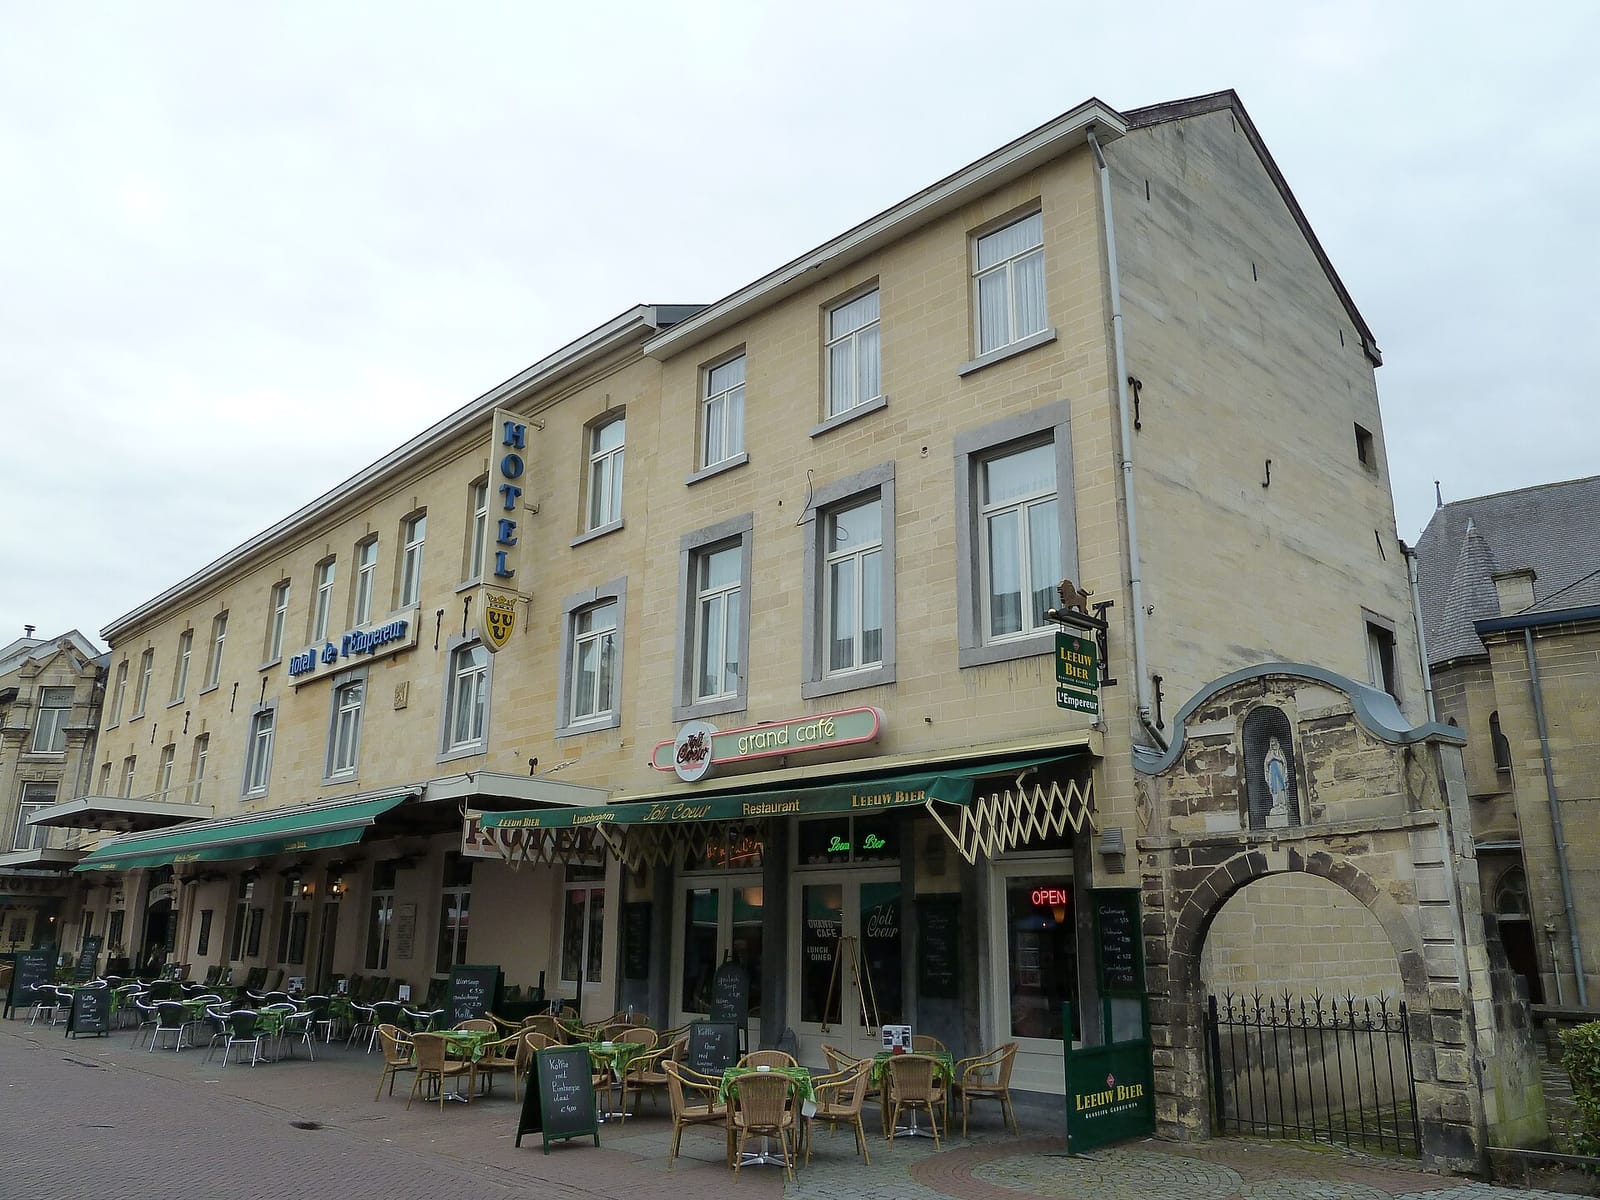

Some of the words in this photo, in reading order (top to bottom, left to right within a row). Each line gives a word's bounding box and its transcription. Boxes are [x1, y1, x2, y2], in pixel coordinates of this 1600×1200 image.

[494, 420, 527, 578] HOTEL
[289, 648, 316, 676] Hotel
[1057, 692, 1098, 710] L'Empereur
[738, 725, 789, 755] grand
[796, 716, 835, 742] café
[743, 800, 800, 815] Restaurant
[1031, 889, 1066, 905] OPEN
